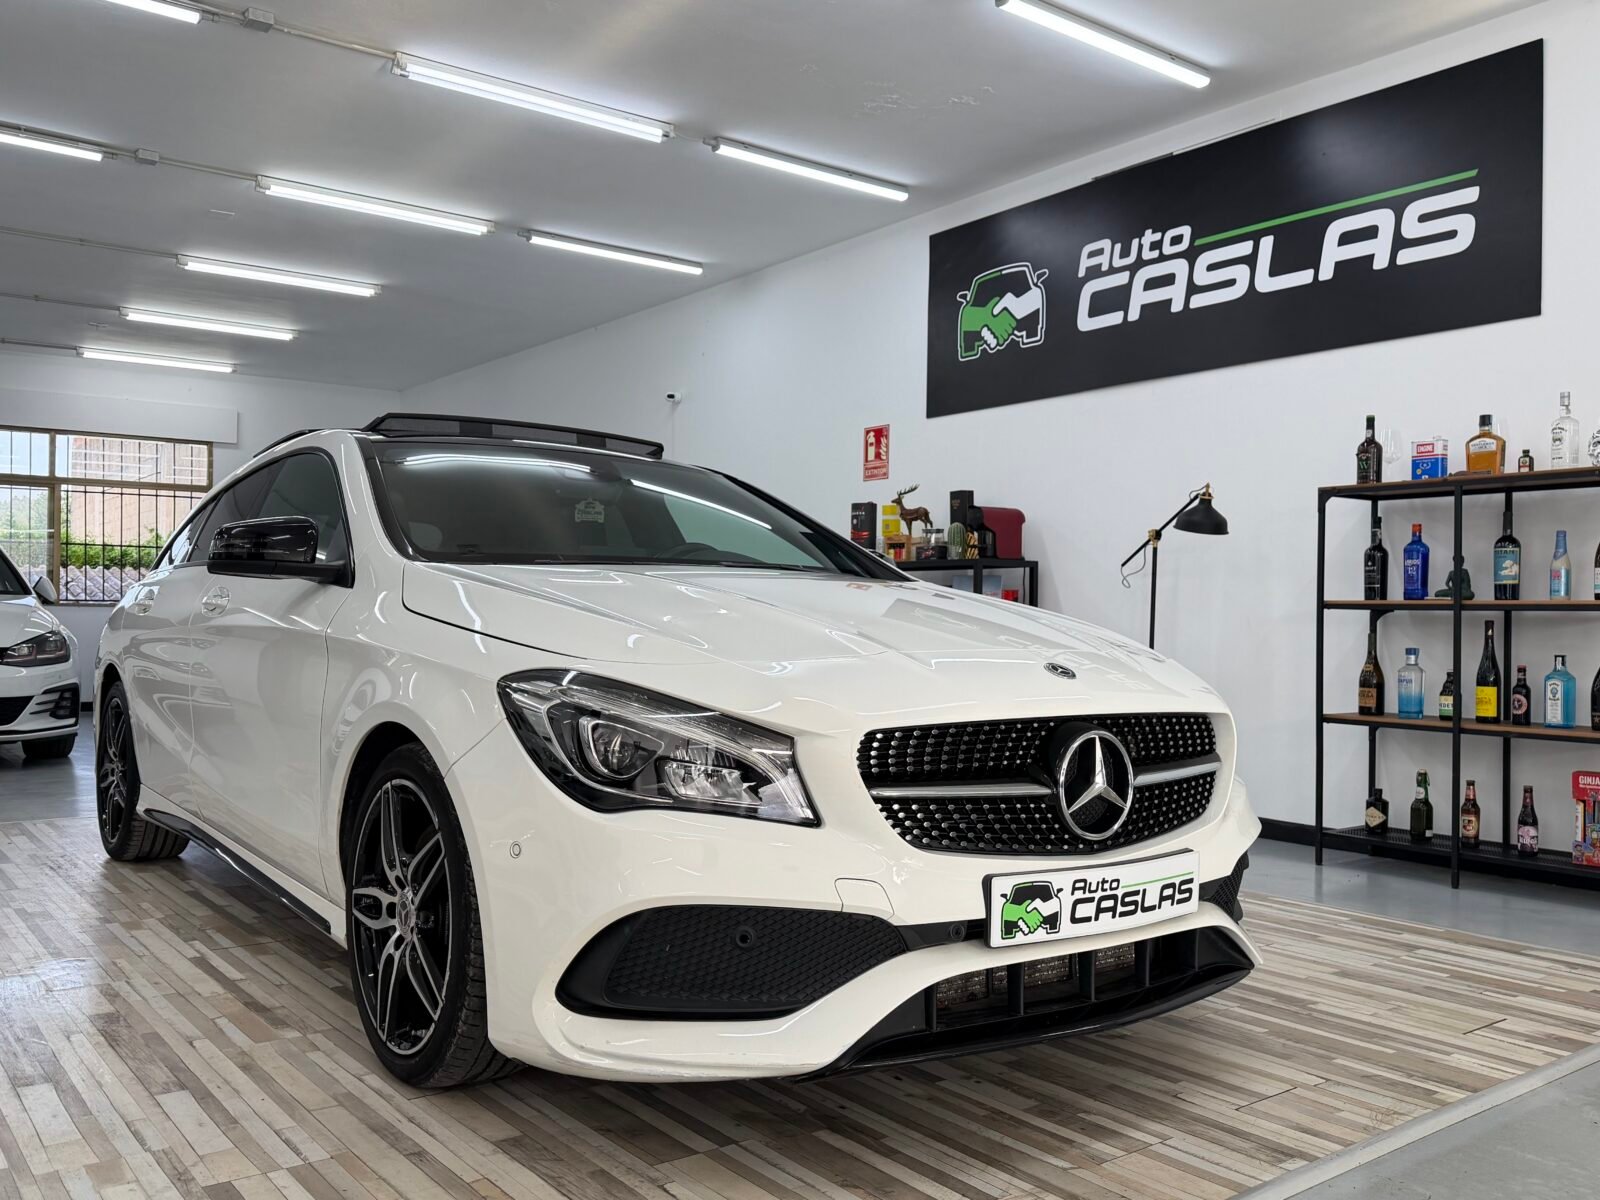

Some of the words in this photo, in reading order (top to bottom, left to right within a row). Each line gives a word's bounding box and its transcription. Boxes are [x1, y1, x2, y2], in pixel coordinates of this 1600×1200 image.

[1077, 186, 1480, 332] CASLAS
[1078, 224, 1192, 278] Auto
[1070, 878, 1194, 924] CASLAS
[1071, 877, 1120, 896] Auto
